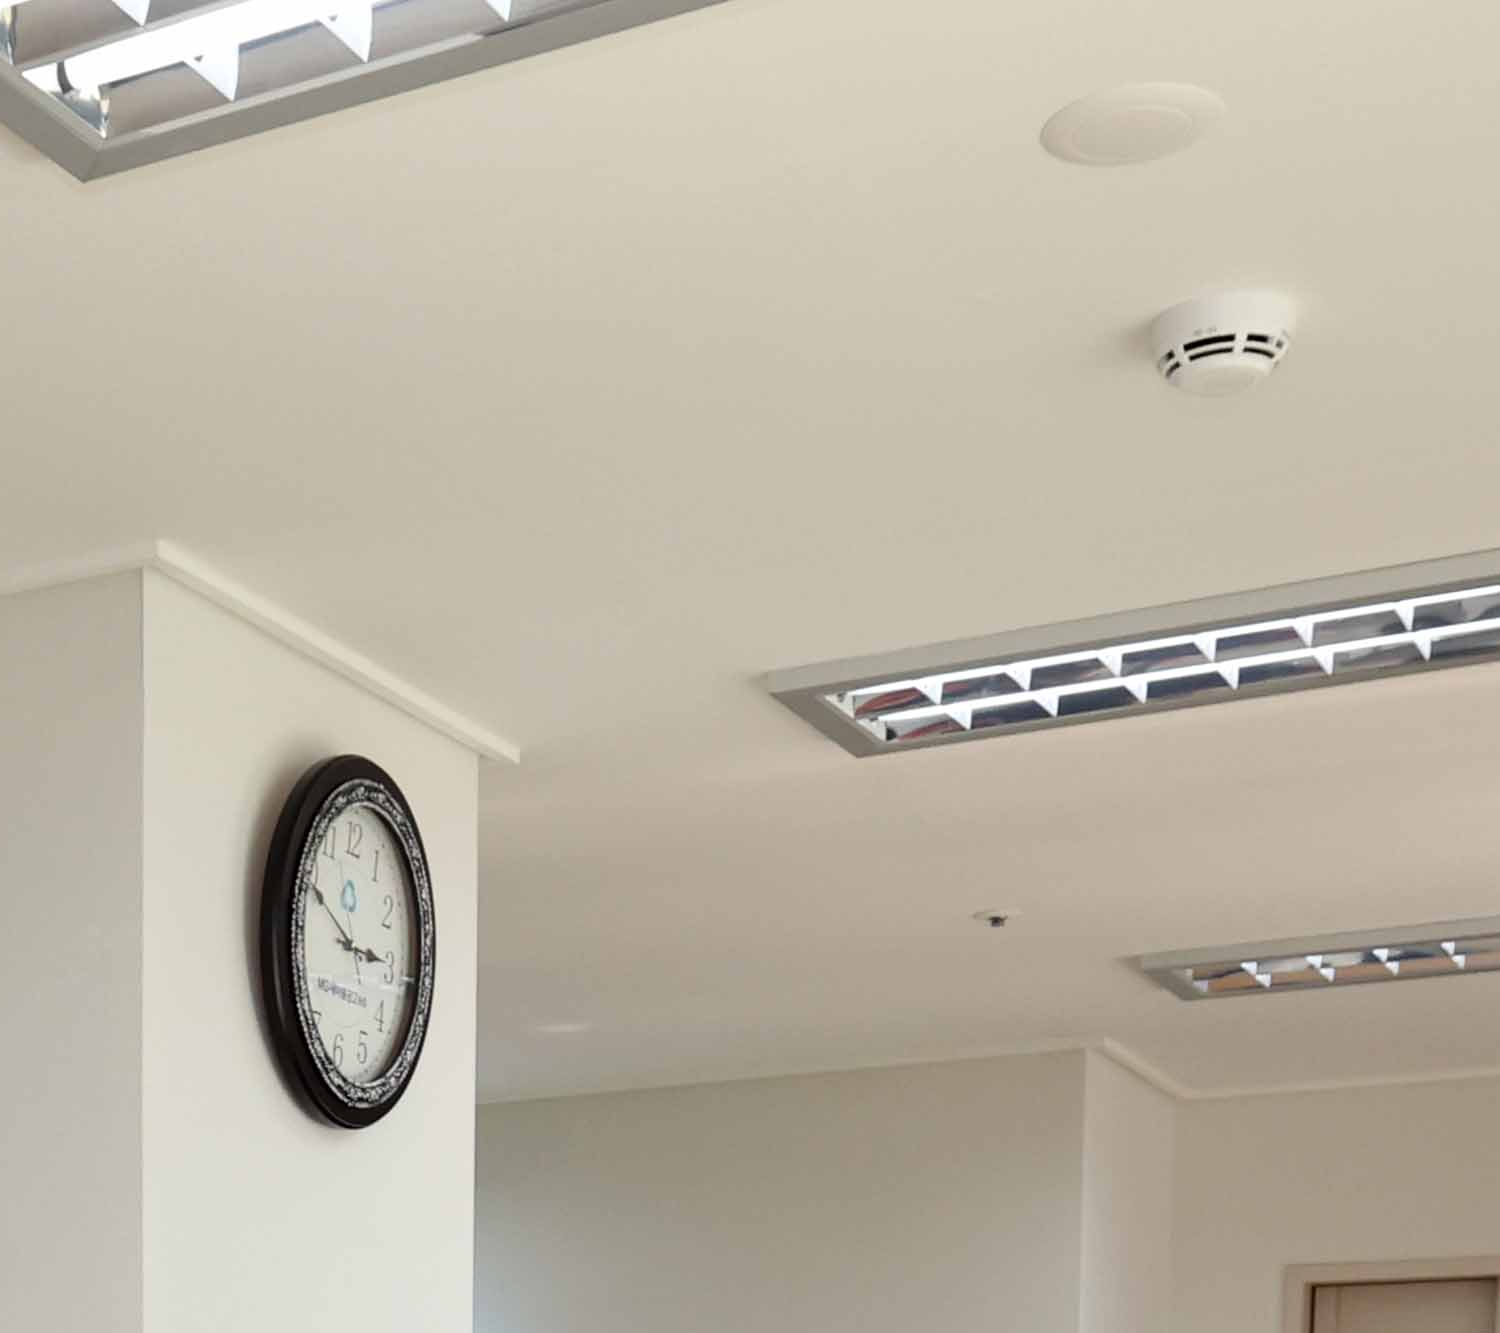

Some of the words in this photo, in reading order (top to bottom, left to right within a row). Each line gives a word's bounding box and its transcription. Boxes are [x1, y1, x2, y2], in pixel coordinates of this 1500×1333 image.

[344, 821, 362, 859] 12
[371, 849, 380, 882] 1
[381, 895, 394, 930] 2
[383, 951, 395, 984] 3
[373, 999, 385, 1033] 4
[332, 1033, 345, 1069] 6
[356, 1029, 369, 1065] 5
